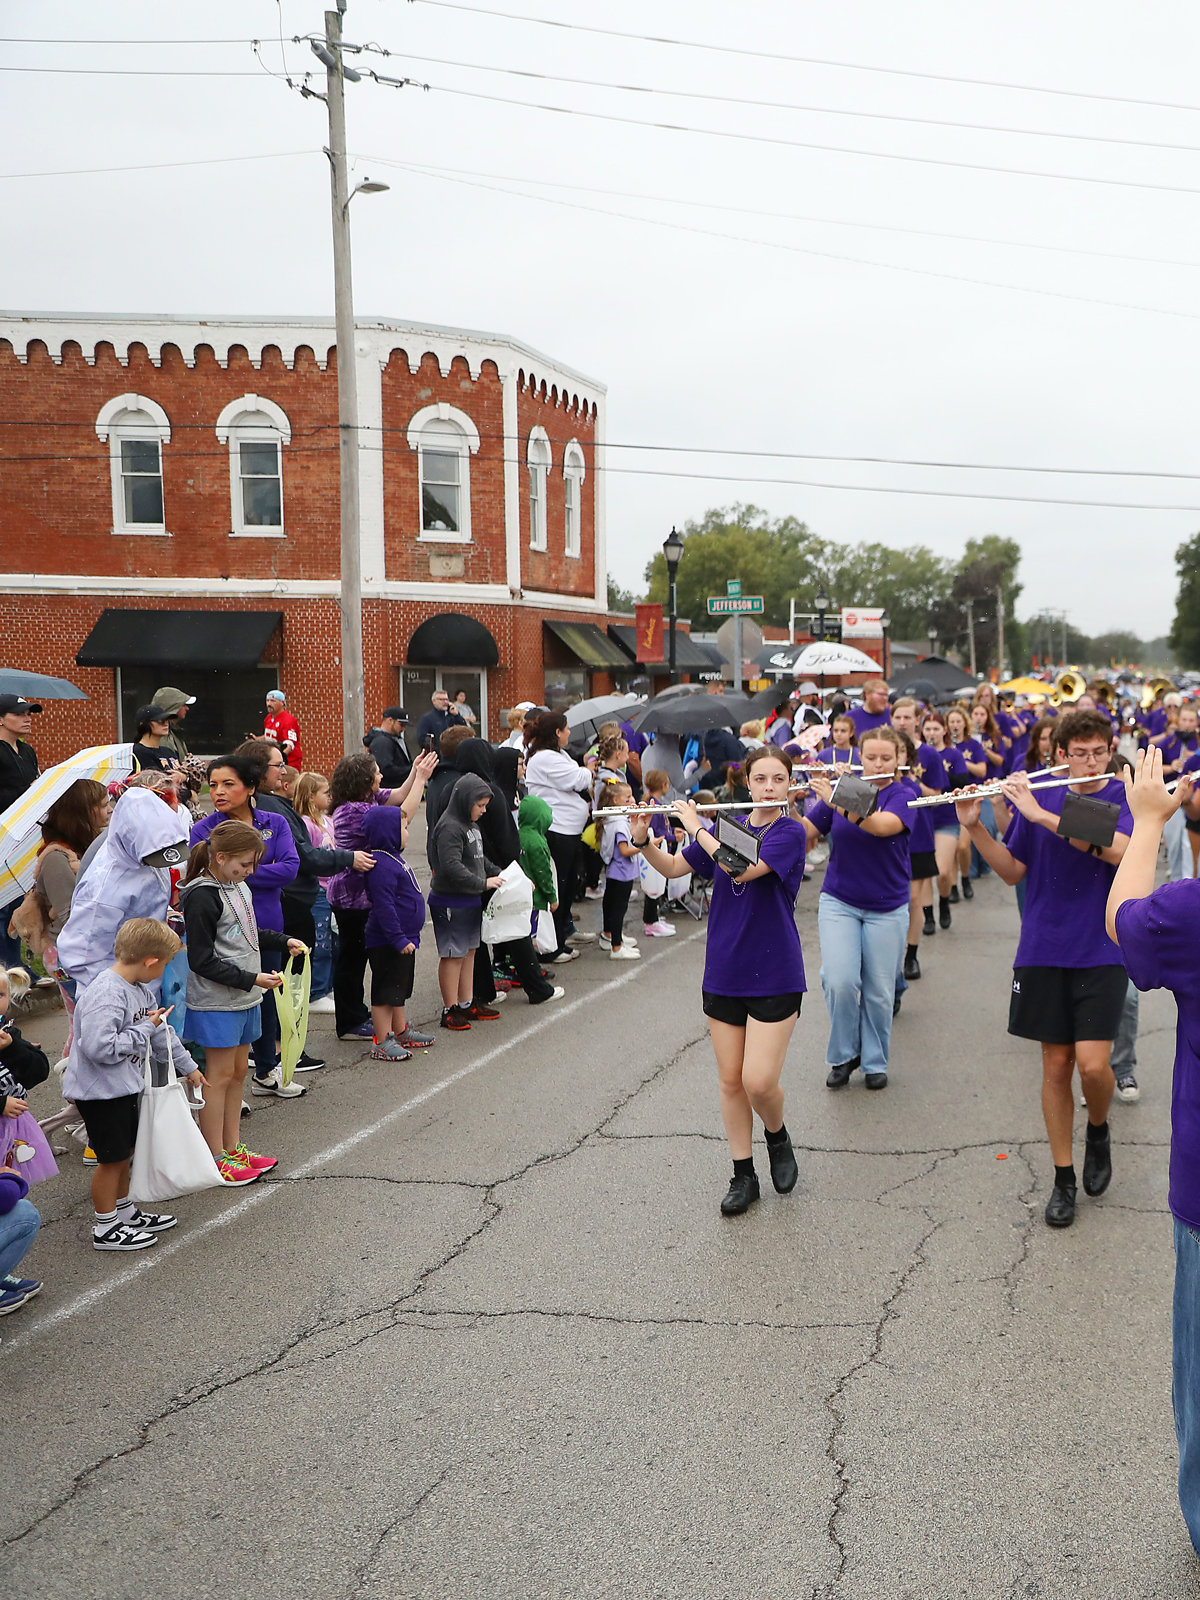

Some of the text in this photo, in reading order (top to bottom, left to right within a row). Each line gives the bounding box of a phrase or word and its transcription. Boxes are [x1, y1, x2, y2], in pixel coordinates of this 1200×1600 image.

[712, 600, 760, 611] JEFFERSON ST
[407, 671, 419, 679] 101
